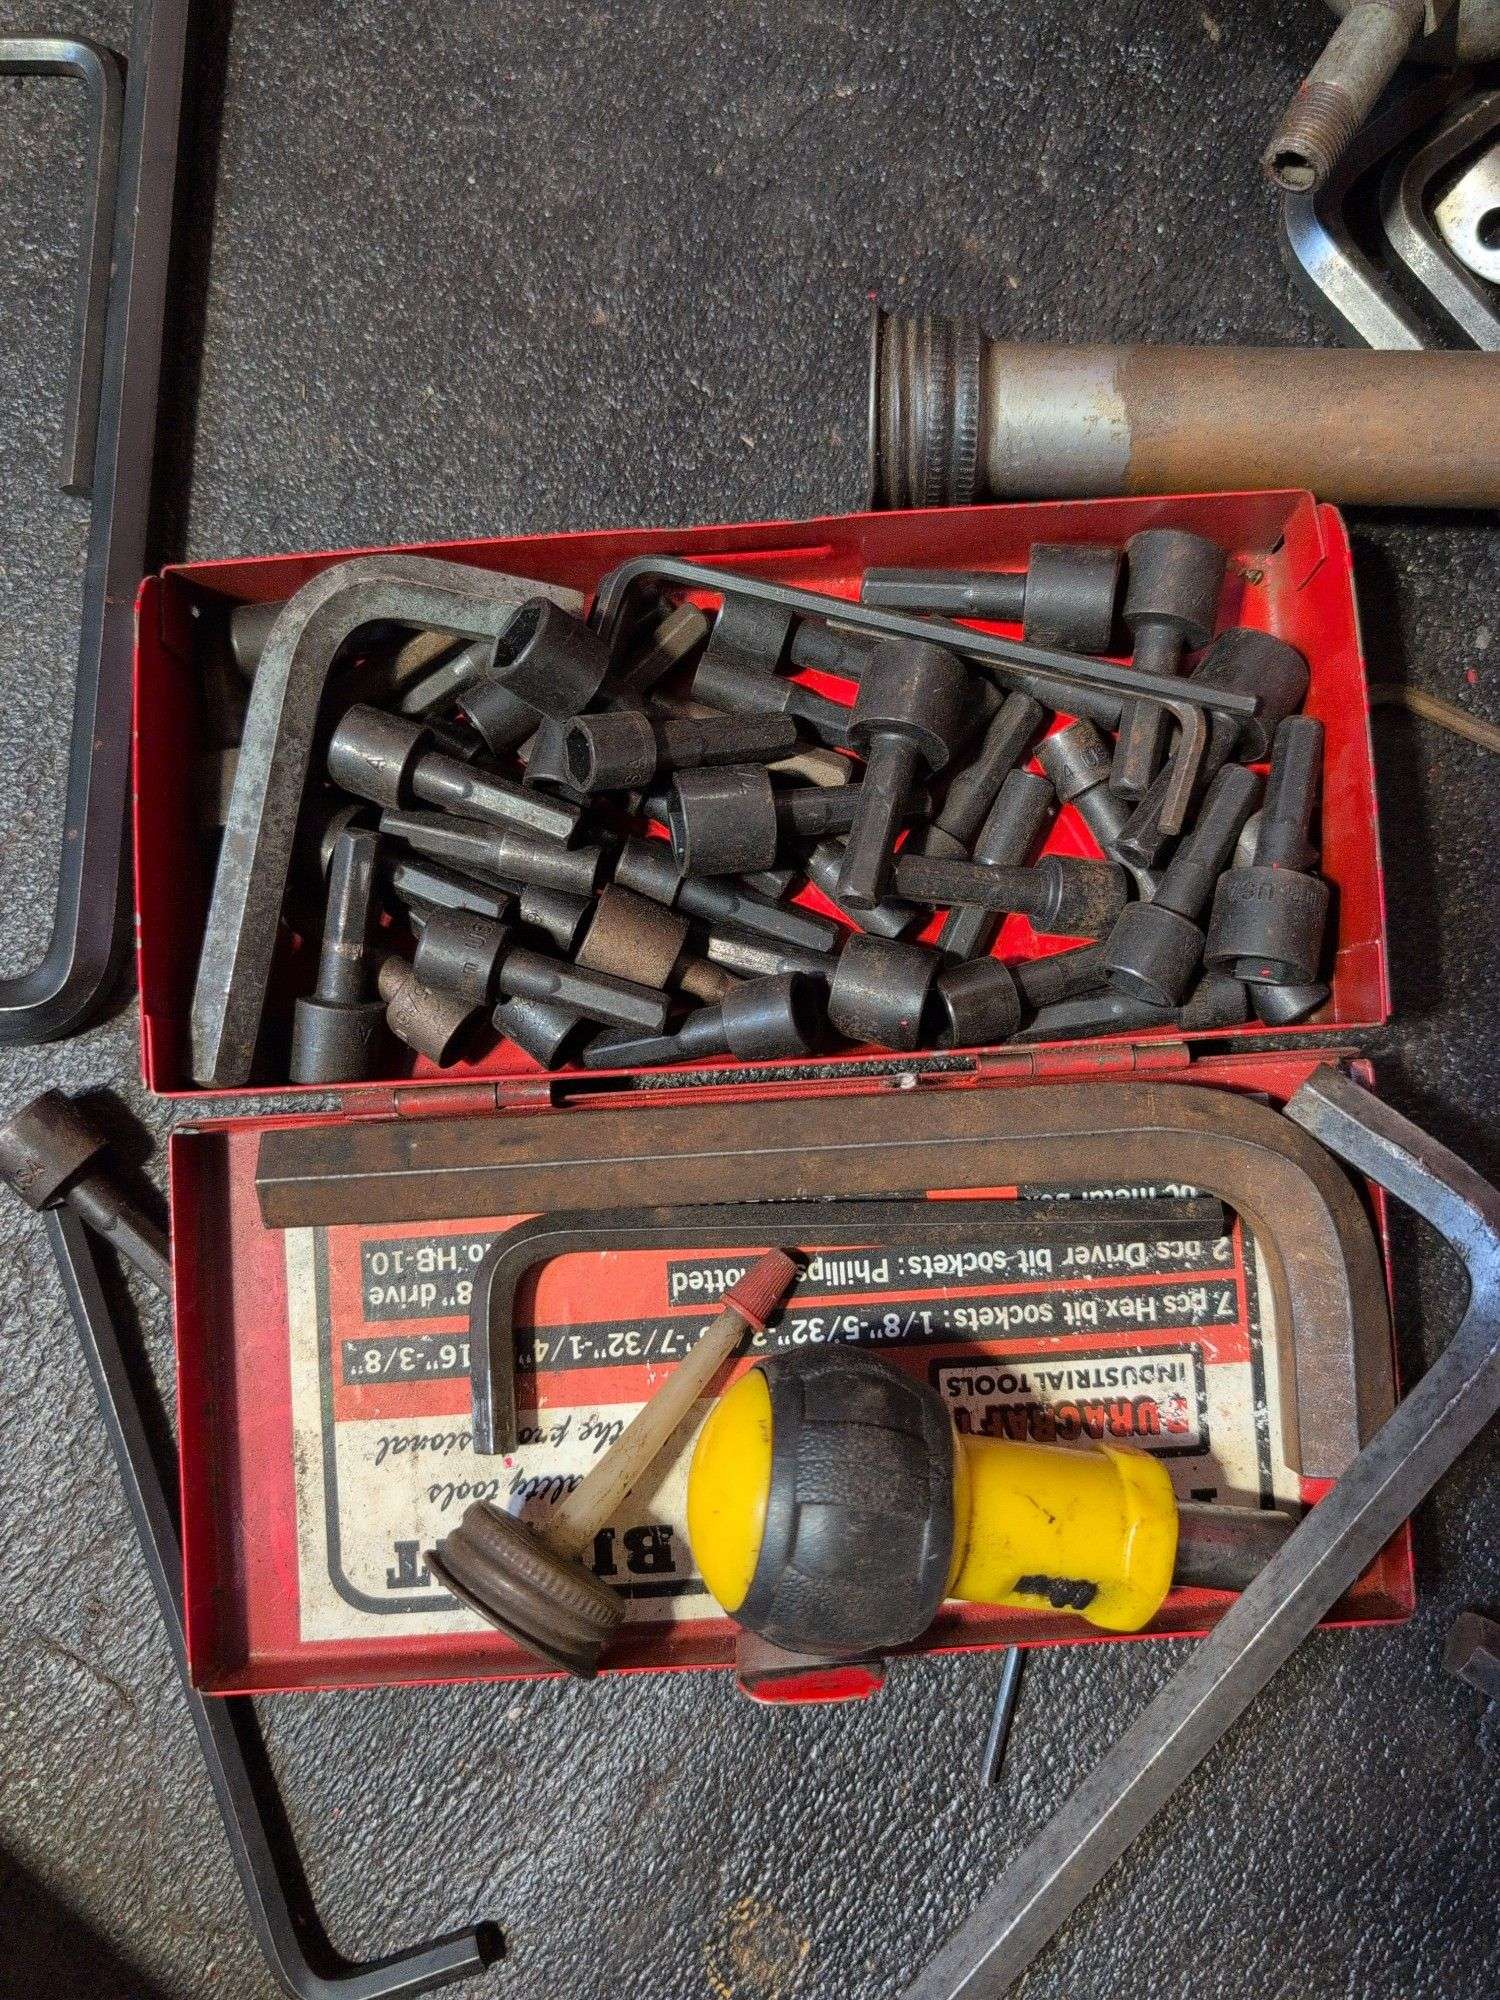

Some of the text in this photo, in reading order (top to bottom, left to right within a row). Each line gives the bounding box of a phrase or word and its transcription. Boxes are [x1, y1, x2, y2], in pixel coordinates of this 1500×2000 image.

[365, 1245, 457, 1276] HB-10.
[1016, 1248, 1051, 1276] bit
[1062, 1241, 1146, 1270] Driver
[1212, 1236, 1230, 1261] 2
[794, 1256, 889, 1287] Phillips
[898, 1249, 1007, 1280] sockets:
[368, 1282, 437, 1310] drive
[672, 1267, 746, 1298] otted
[1062, 1300, 1098, 1327] bit
[1104, 1296, 1156, 1323] Hex
[1162, 1287, 1208, 1315] pcs
[943, 1303, 1054, 1332] sockets:
[946, 1362, 1186, 1398] INDUSTRIAL TOOLS
[375, 1414, 625, 1467] the prosional
[426, 1467, 584, 1513] ality tools
[593, 1525, 676, 1577] BI
